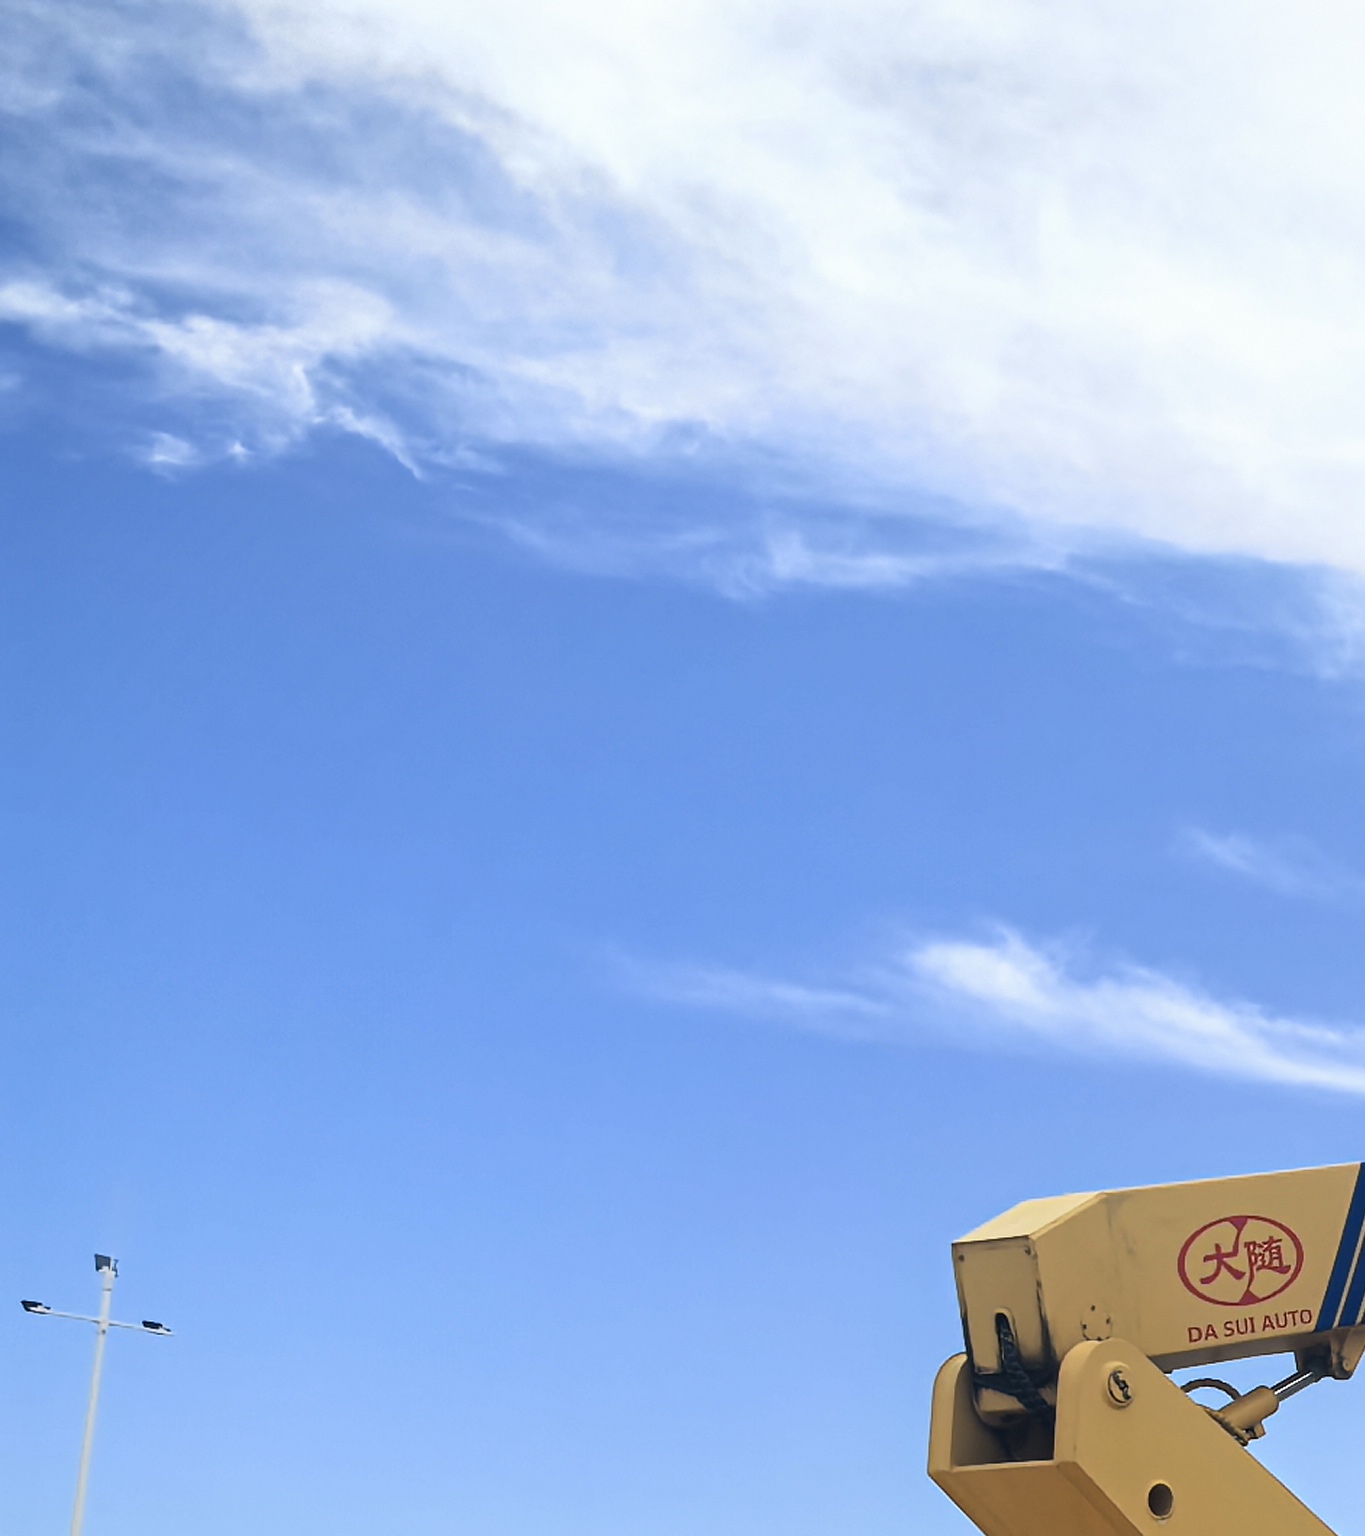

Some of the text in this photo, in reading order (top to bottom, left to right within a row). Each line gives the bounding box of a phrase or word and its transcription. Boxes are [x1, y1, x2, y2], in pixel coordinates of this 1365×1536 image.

[1187, 1308, 1313, 1343] DA SUI AUTO
